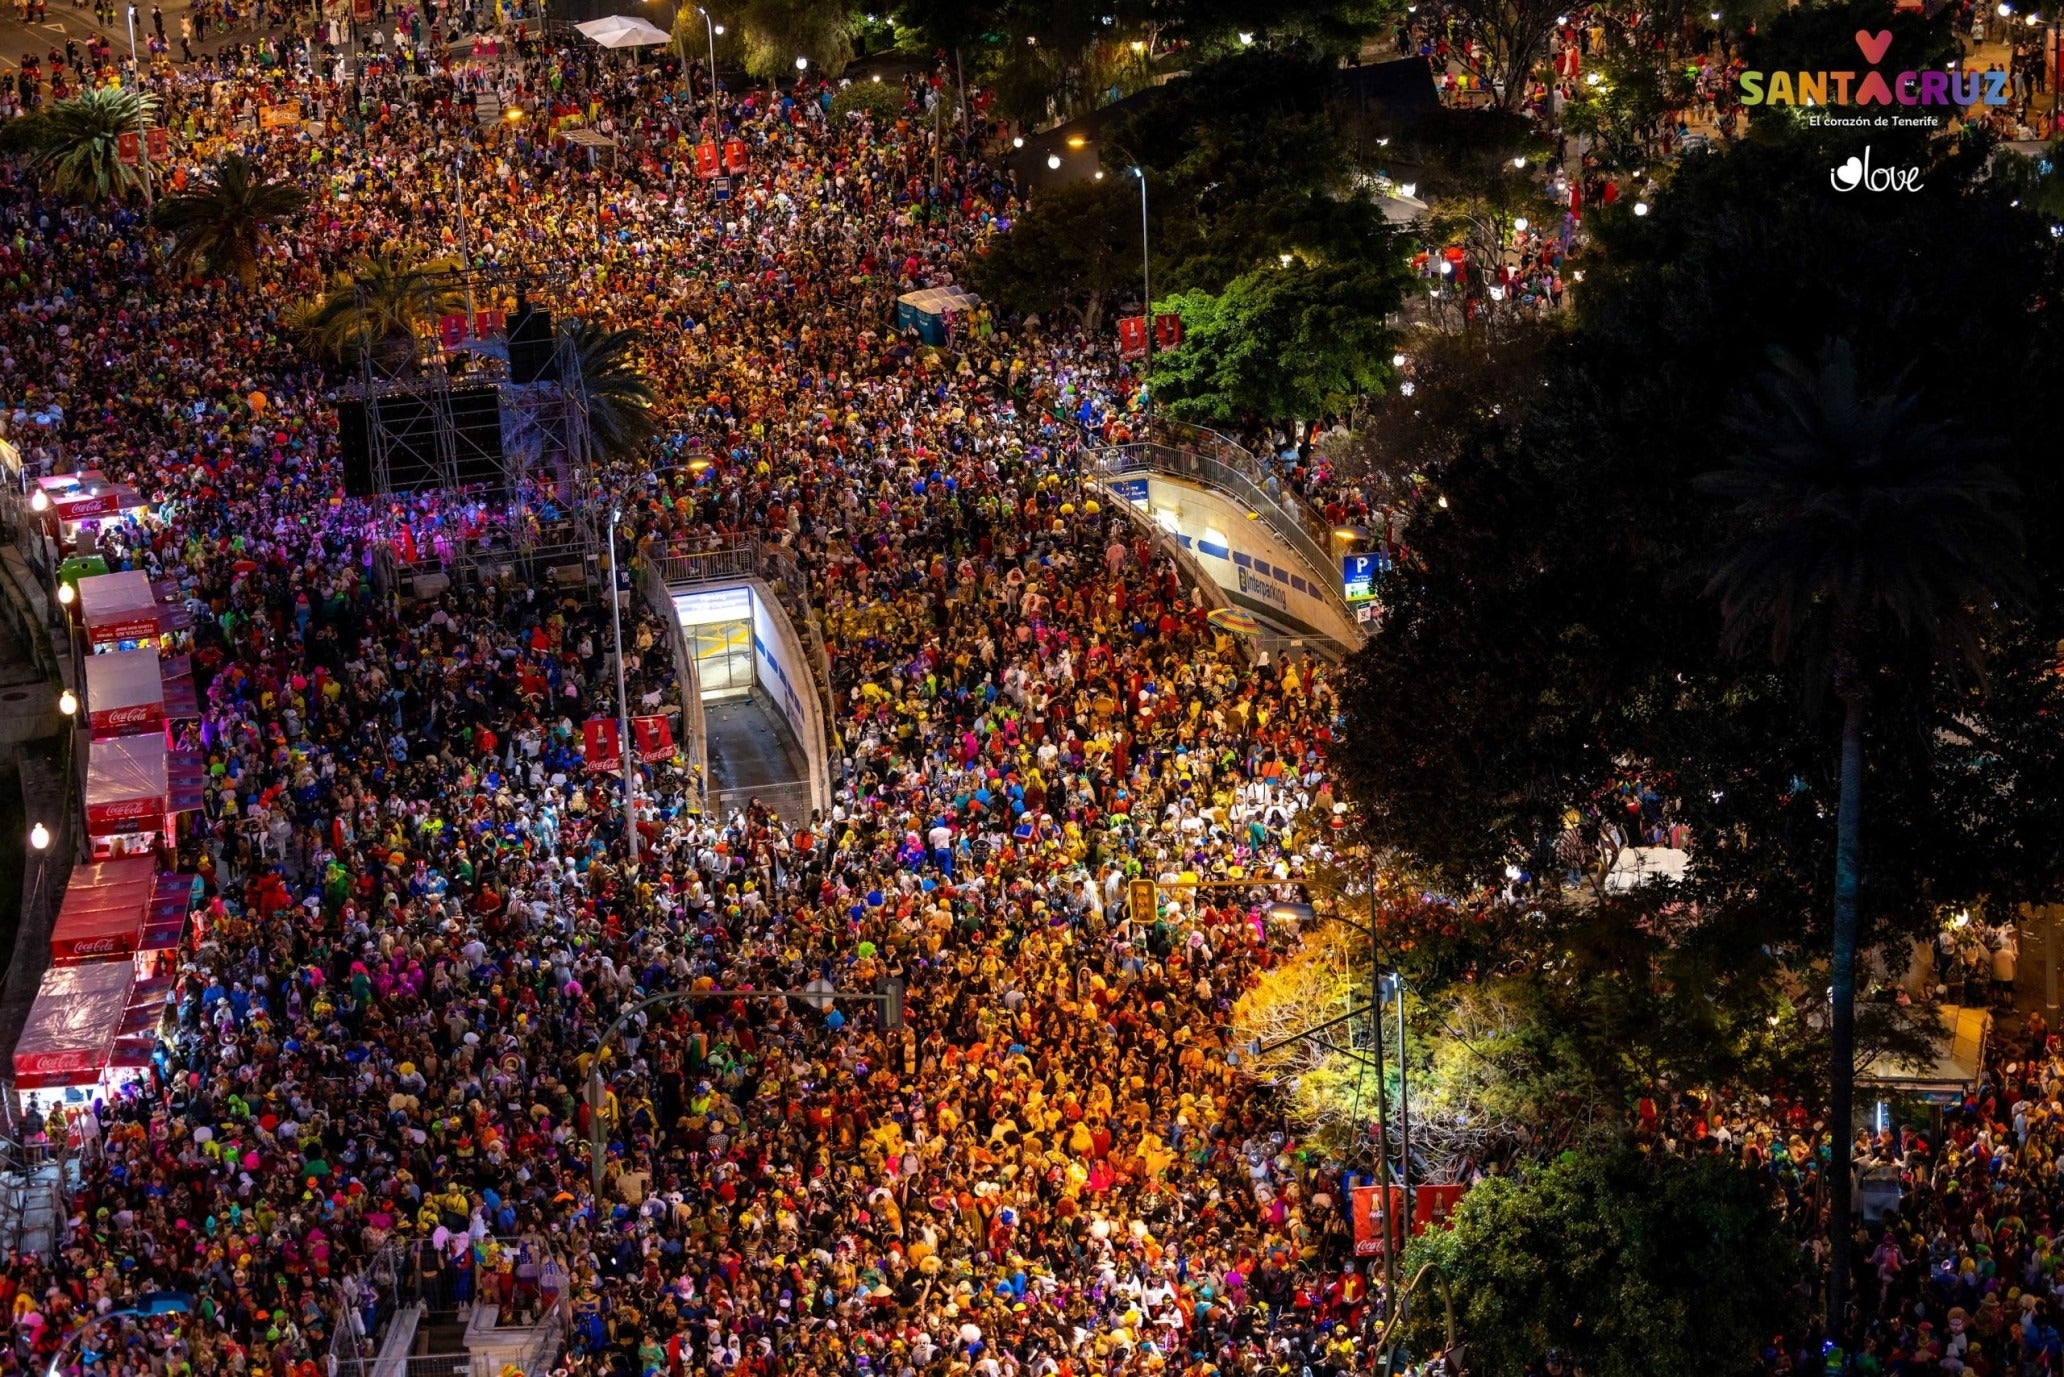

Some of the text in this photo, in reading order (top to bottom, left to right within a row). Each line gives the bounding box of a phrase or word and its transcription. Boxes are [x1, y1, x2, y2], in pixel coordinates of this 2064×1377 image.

[71, 501, 102, 514] Coca-Cola
[1357, 557, 1369, 574] P
[1246, 569, 1287, 611] Interparking
[108, 708, 147, 724] Coca-Cola
[644, 746, 674, 763] Coca-Cola
[588, 758, 619, 771] Coca-Cola
[106, 802, 145, 816] Coca-Cola
[73, 939, 113, 954] Coca-Cola
[36, 1054, 80, 1070] Coca-Cola
